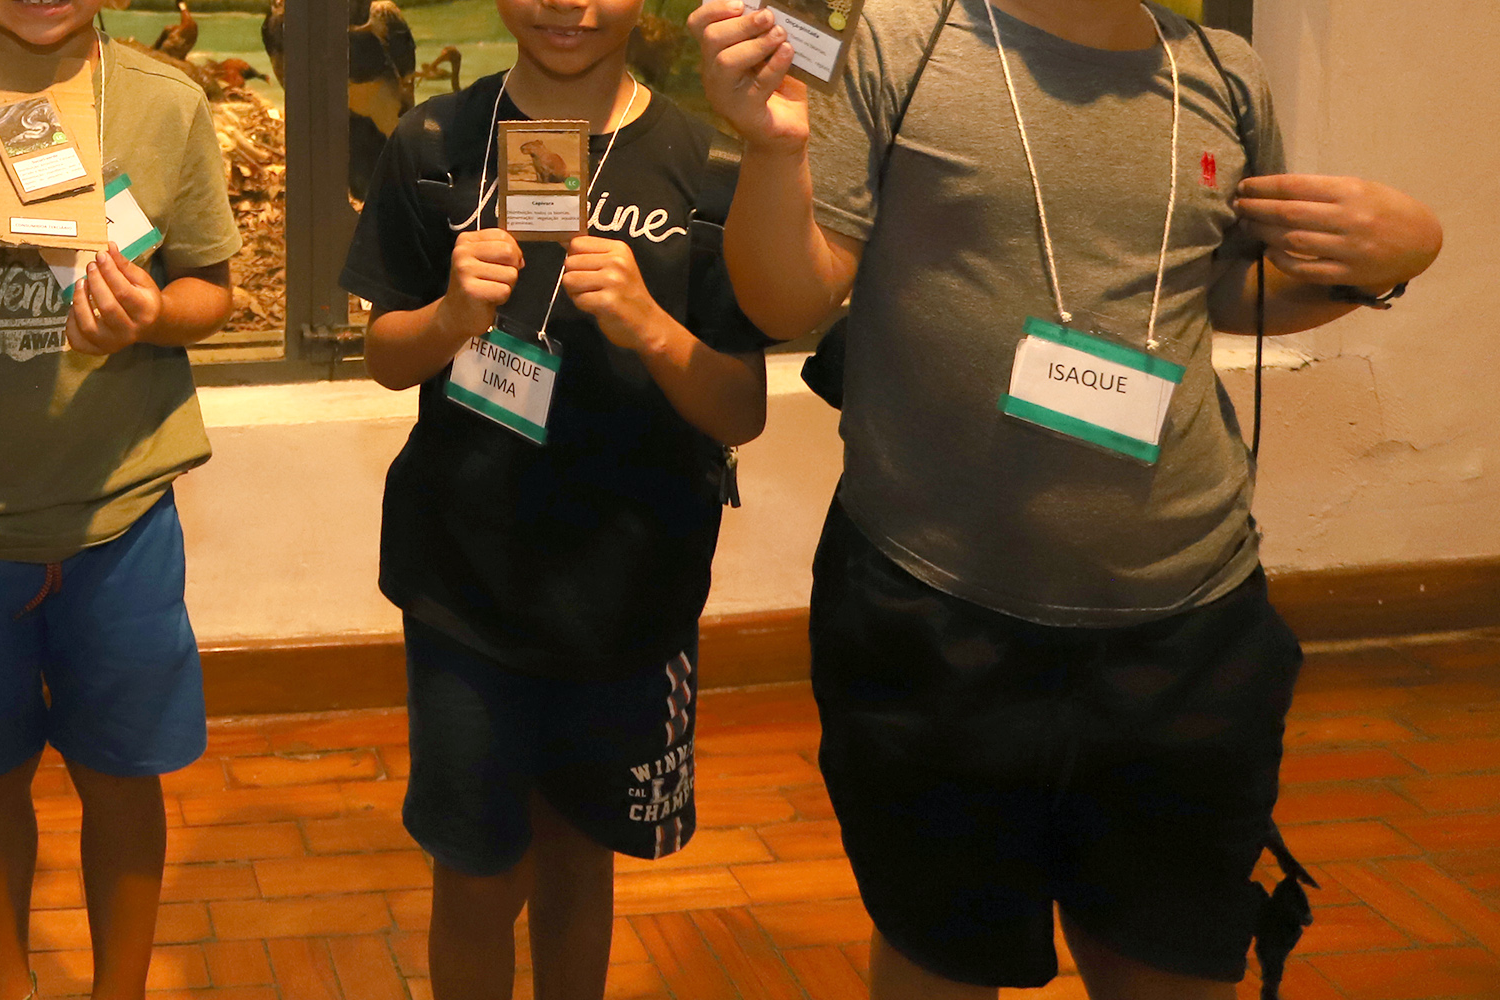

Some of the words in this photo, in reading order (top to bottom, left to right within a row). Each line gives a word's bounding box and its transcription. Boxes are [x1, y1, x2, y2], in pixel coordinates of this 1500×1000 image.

[470, 336, 541, 382] HENRIQUE
[482, 369, 516, 398] LIMA
[1048, 362, 1128, 394] ISAQUE
[628, 788, 646, 798] CAL
